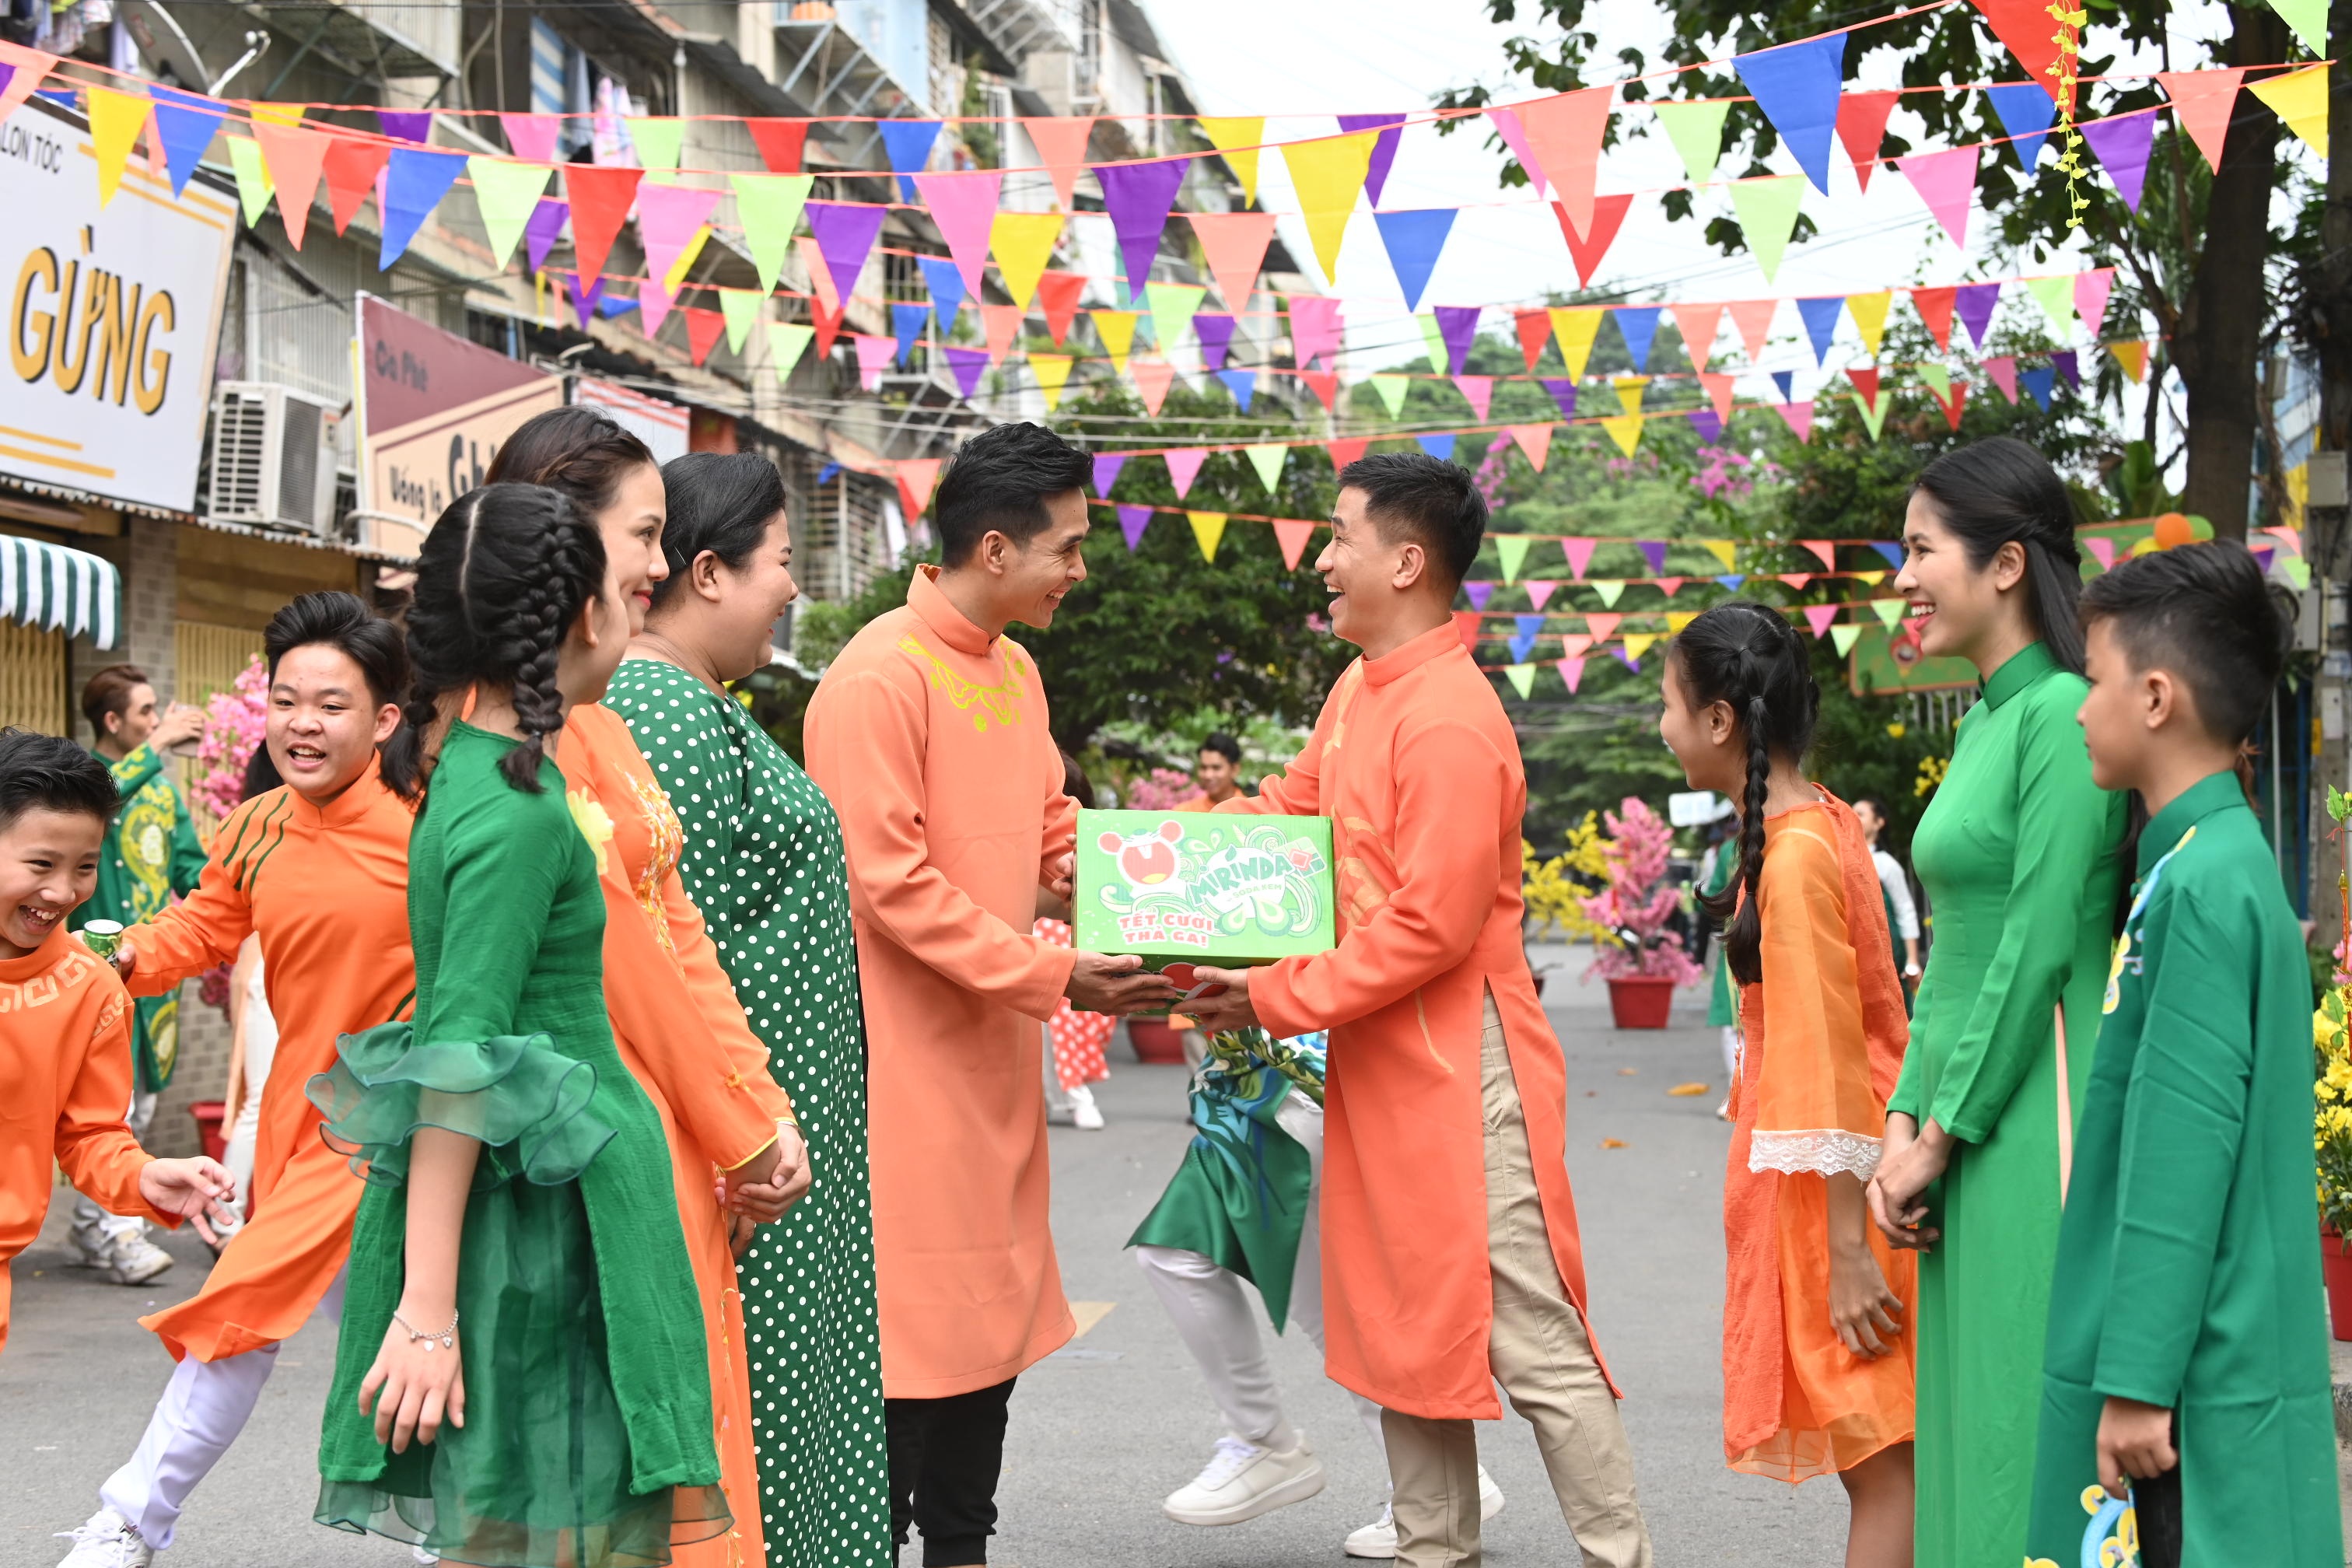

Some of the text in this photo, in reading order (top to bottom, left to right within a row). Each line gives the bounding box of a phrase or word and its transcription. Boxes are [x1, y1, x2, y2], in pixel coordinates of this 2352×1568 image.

[34, 132, 63, 174] TÓC
[10, 223, 177, 417] GỪNG
[1233, 886, 1260, 898] SODA
[1119, 910, 1213, 932] TẾT CƯỜI
[1125, 926, 1207, 947] THẢ GA!
